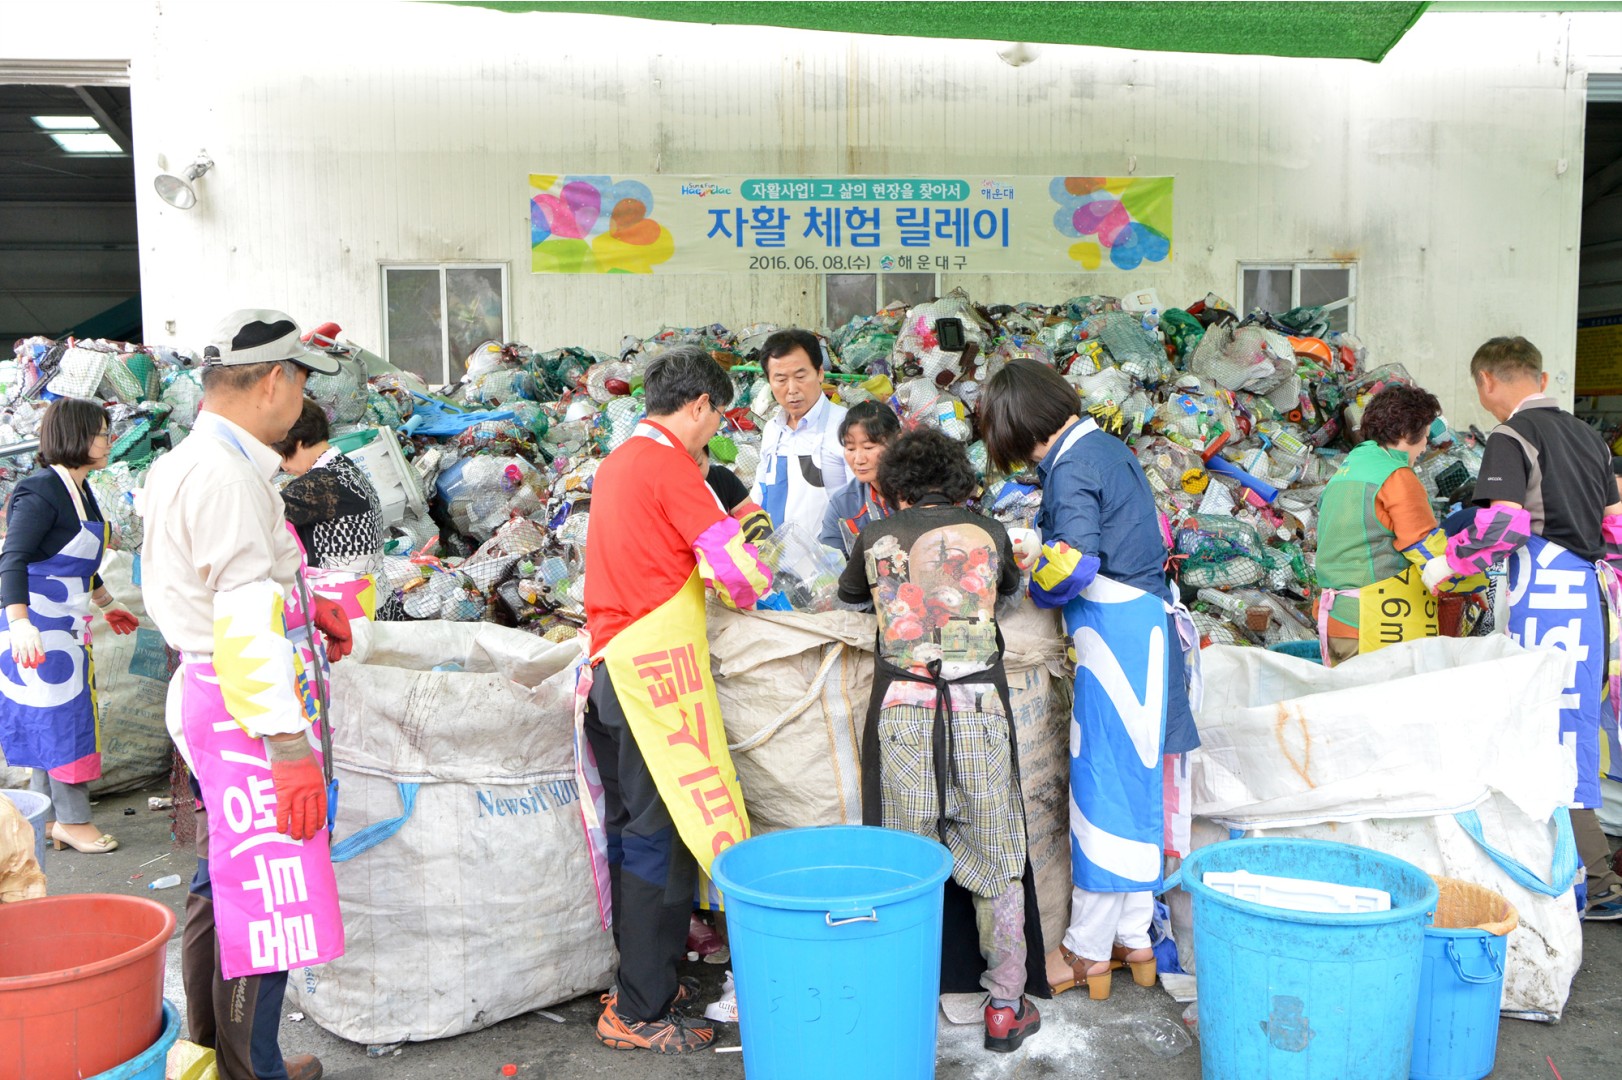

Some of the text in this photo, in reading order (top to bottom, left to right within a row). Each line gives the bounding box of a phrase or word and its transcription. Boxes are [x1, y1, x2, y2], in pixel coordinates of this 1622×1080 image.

[752, 182, 814, 199] 자활사업!
[820, 184, 834, 197] 그
[838, 182, 866, 199] 삶의
[872, 182, 915, 199] 현장을
[919, 182, 961, 199] 찾아서
[981, 188, 1014, 200] 해운대
[706, 205, 1009, 248] 자활 체험 릴레이
[749, 255, 790, 270] 2016.
[794, 255, 818, 270] 06.
